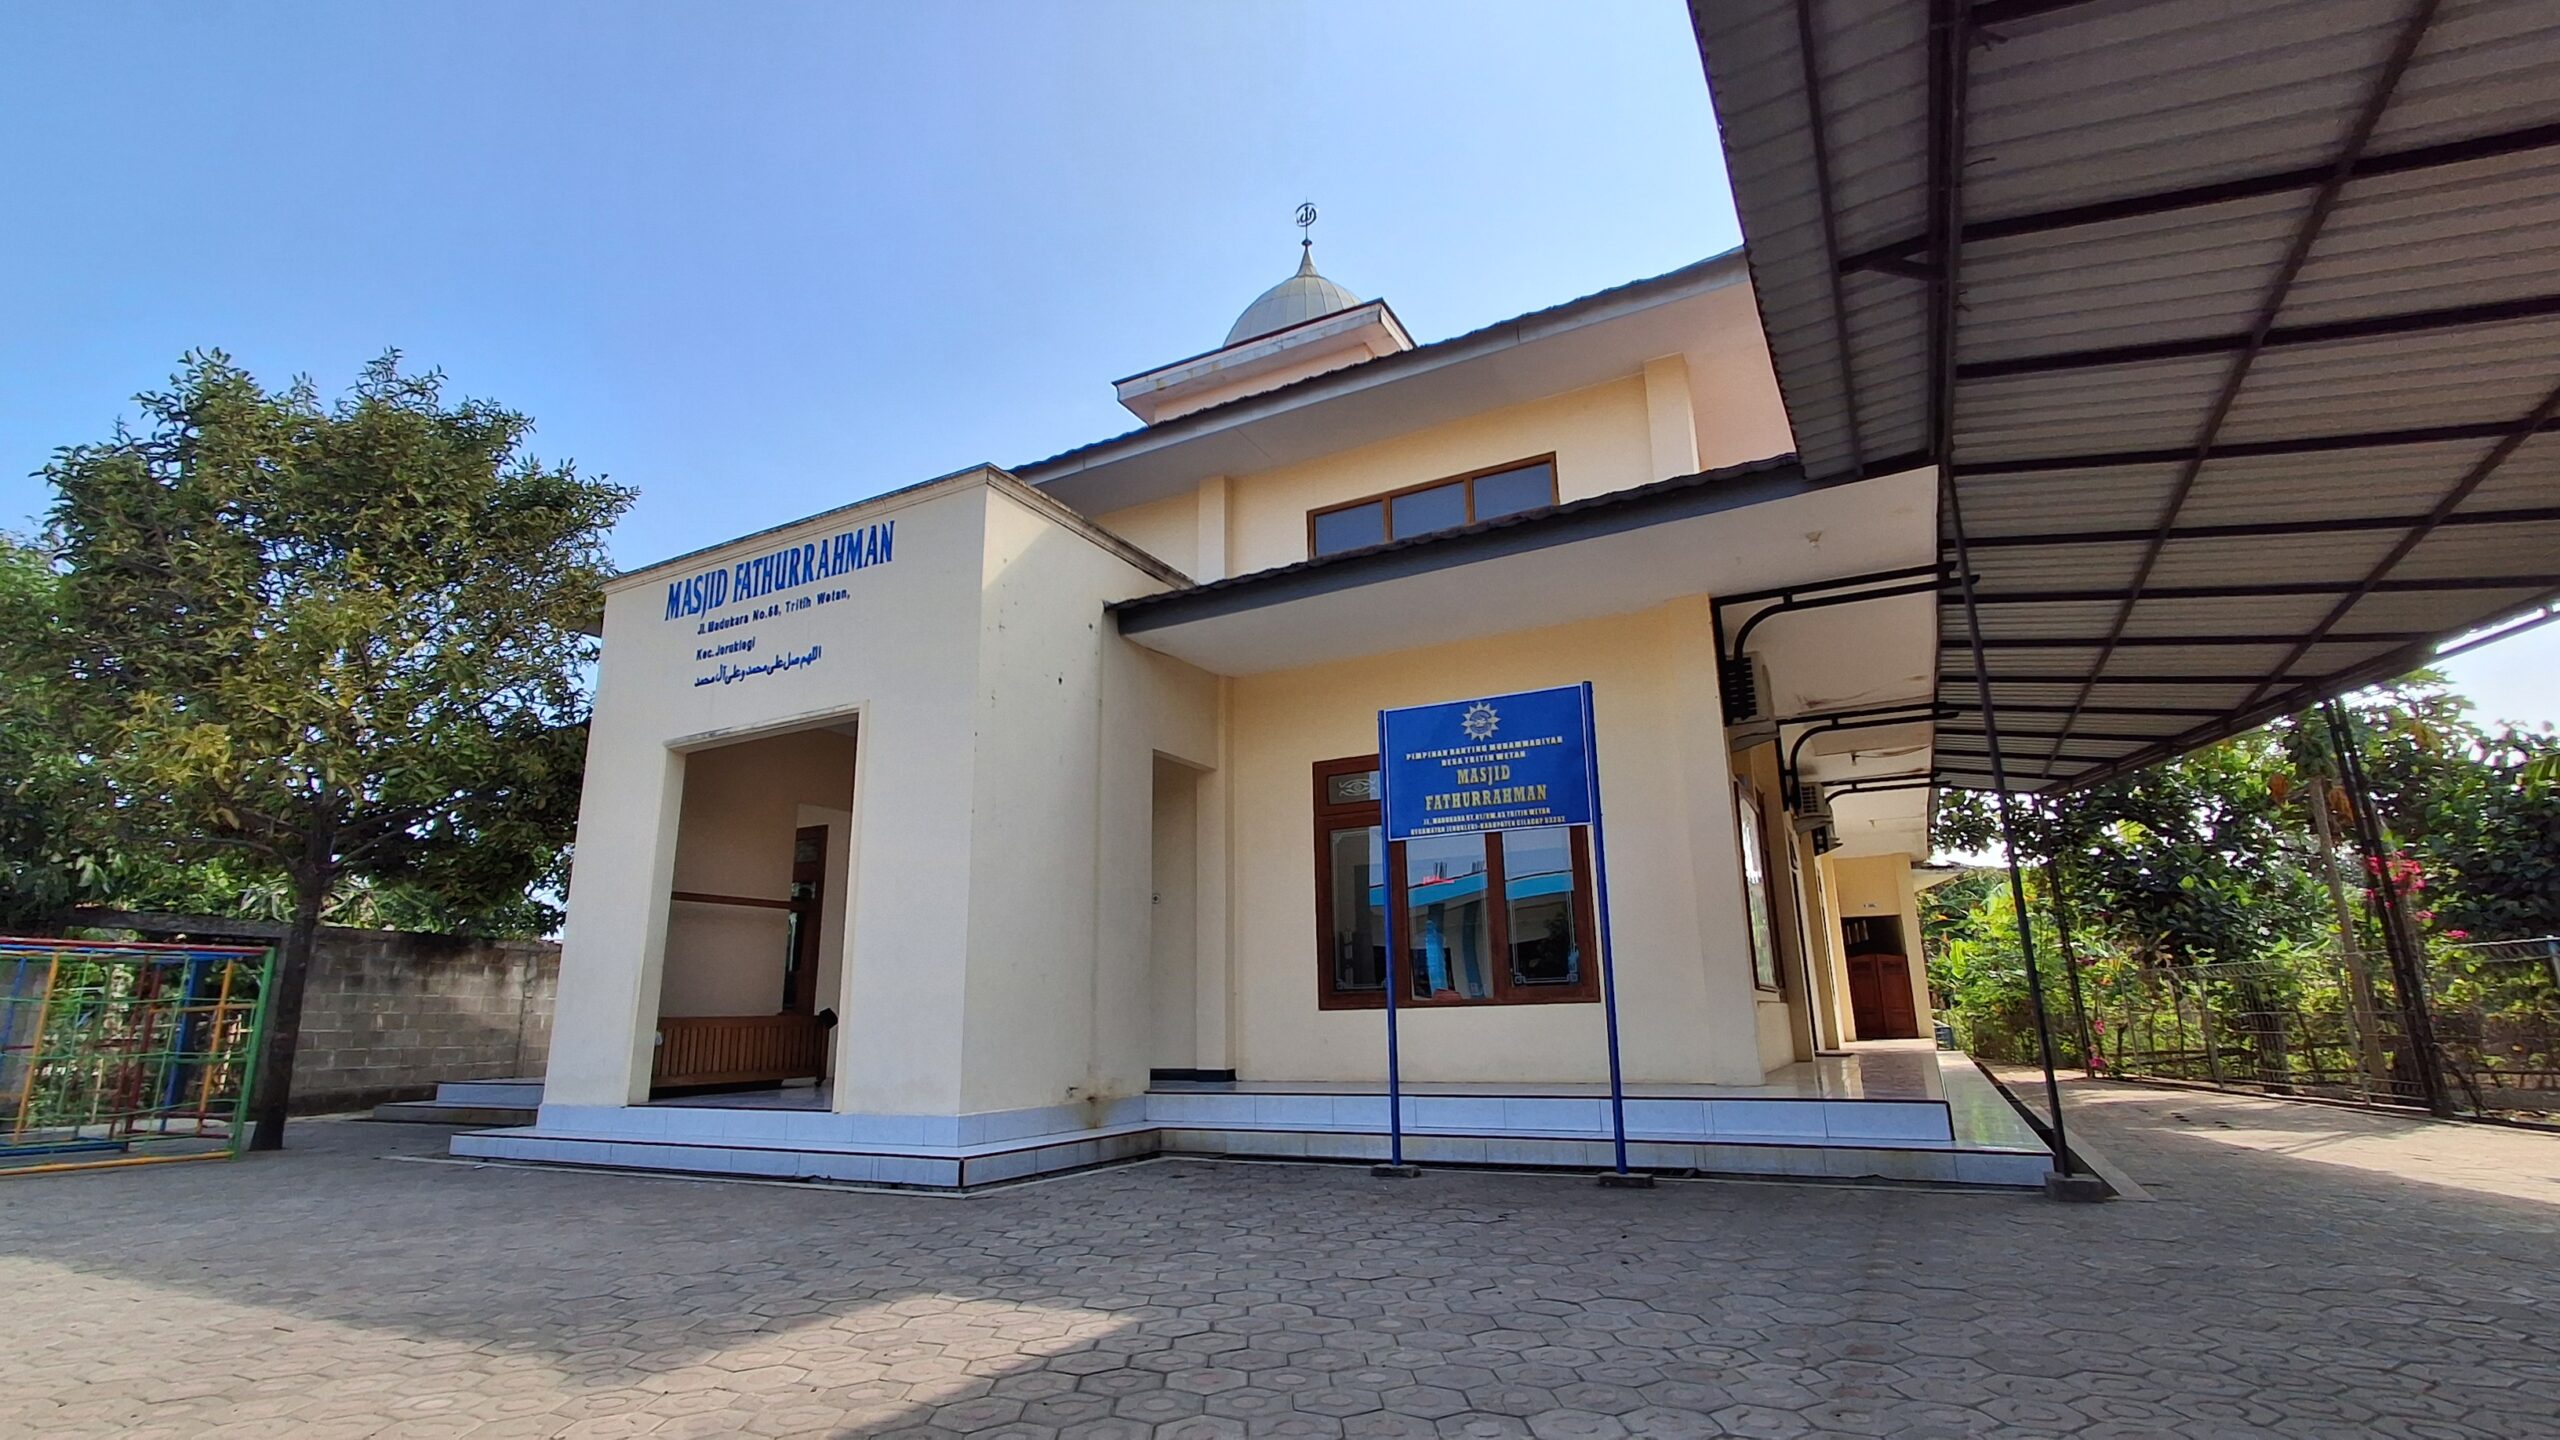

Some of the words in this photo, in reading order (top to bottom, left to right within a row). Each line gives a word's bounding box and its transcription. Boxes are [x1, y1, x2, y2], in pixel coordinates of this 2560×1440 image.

[664, 568, 728, 621] MASJID
[732, 520, 895, 603] FATHURRAHMAN
[785, 597, 812, 613] Tritih
[1406, 750, 1448, 760] PIMPINAN
[1489, 736, 1563, 751] MUHAMMADIYAH
[1495, 751, 1526, 760] WETAN
[1457, 765, 1511, 786] MASJID
[1425, 784, 1547, 811] FATHURRAHMAN
